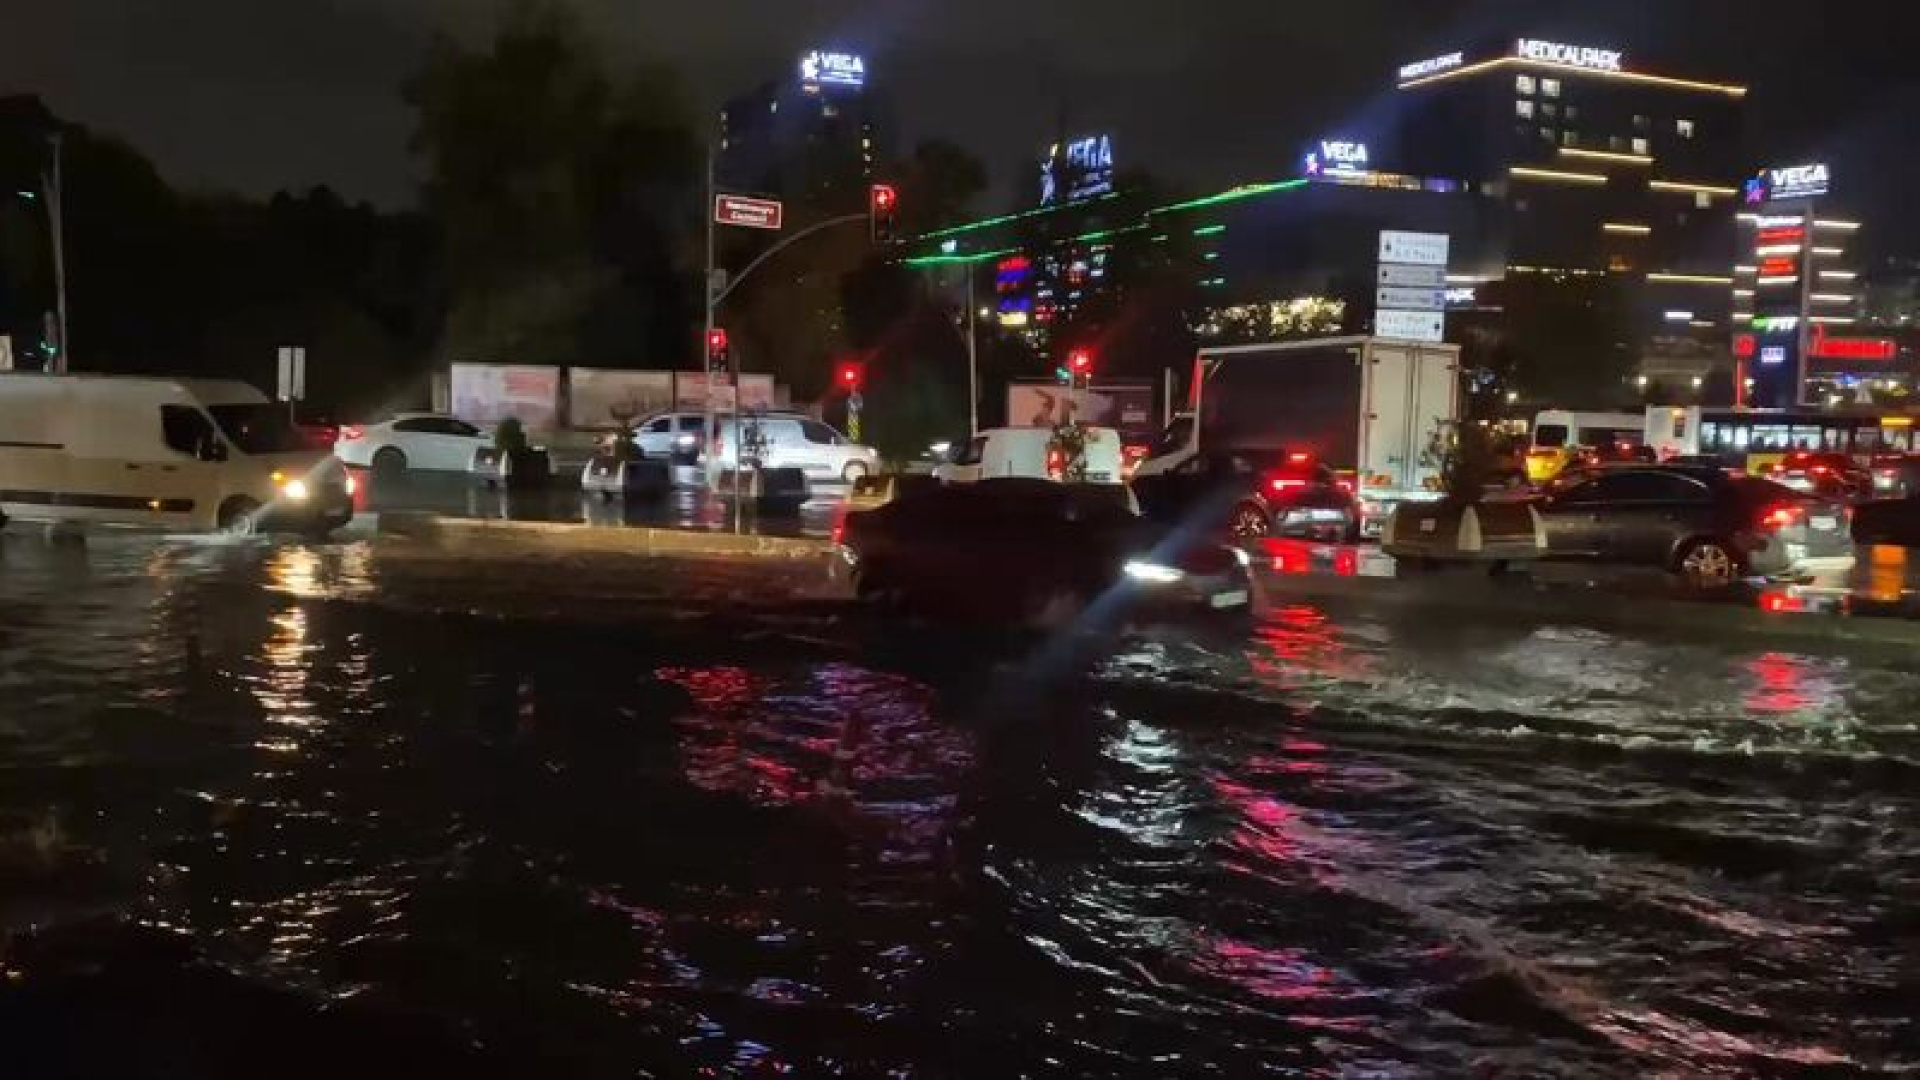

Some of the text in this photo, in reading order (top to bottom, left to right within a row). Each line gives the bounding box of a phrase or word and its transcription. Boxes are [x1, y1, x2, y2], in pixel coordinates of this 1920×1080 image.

[821, 53, 863, 73] VEGA
[1322, 141, 1366, 162] VEGA
[1770, 163, 1827, 186] VEGA
